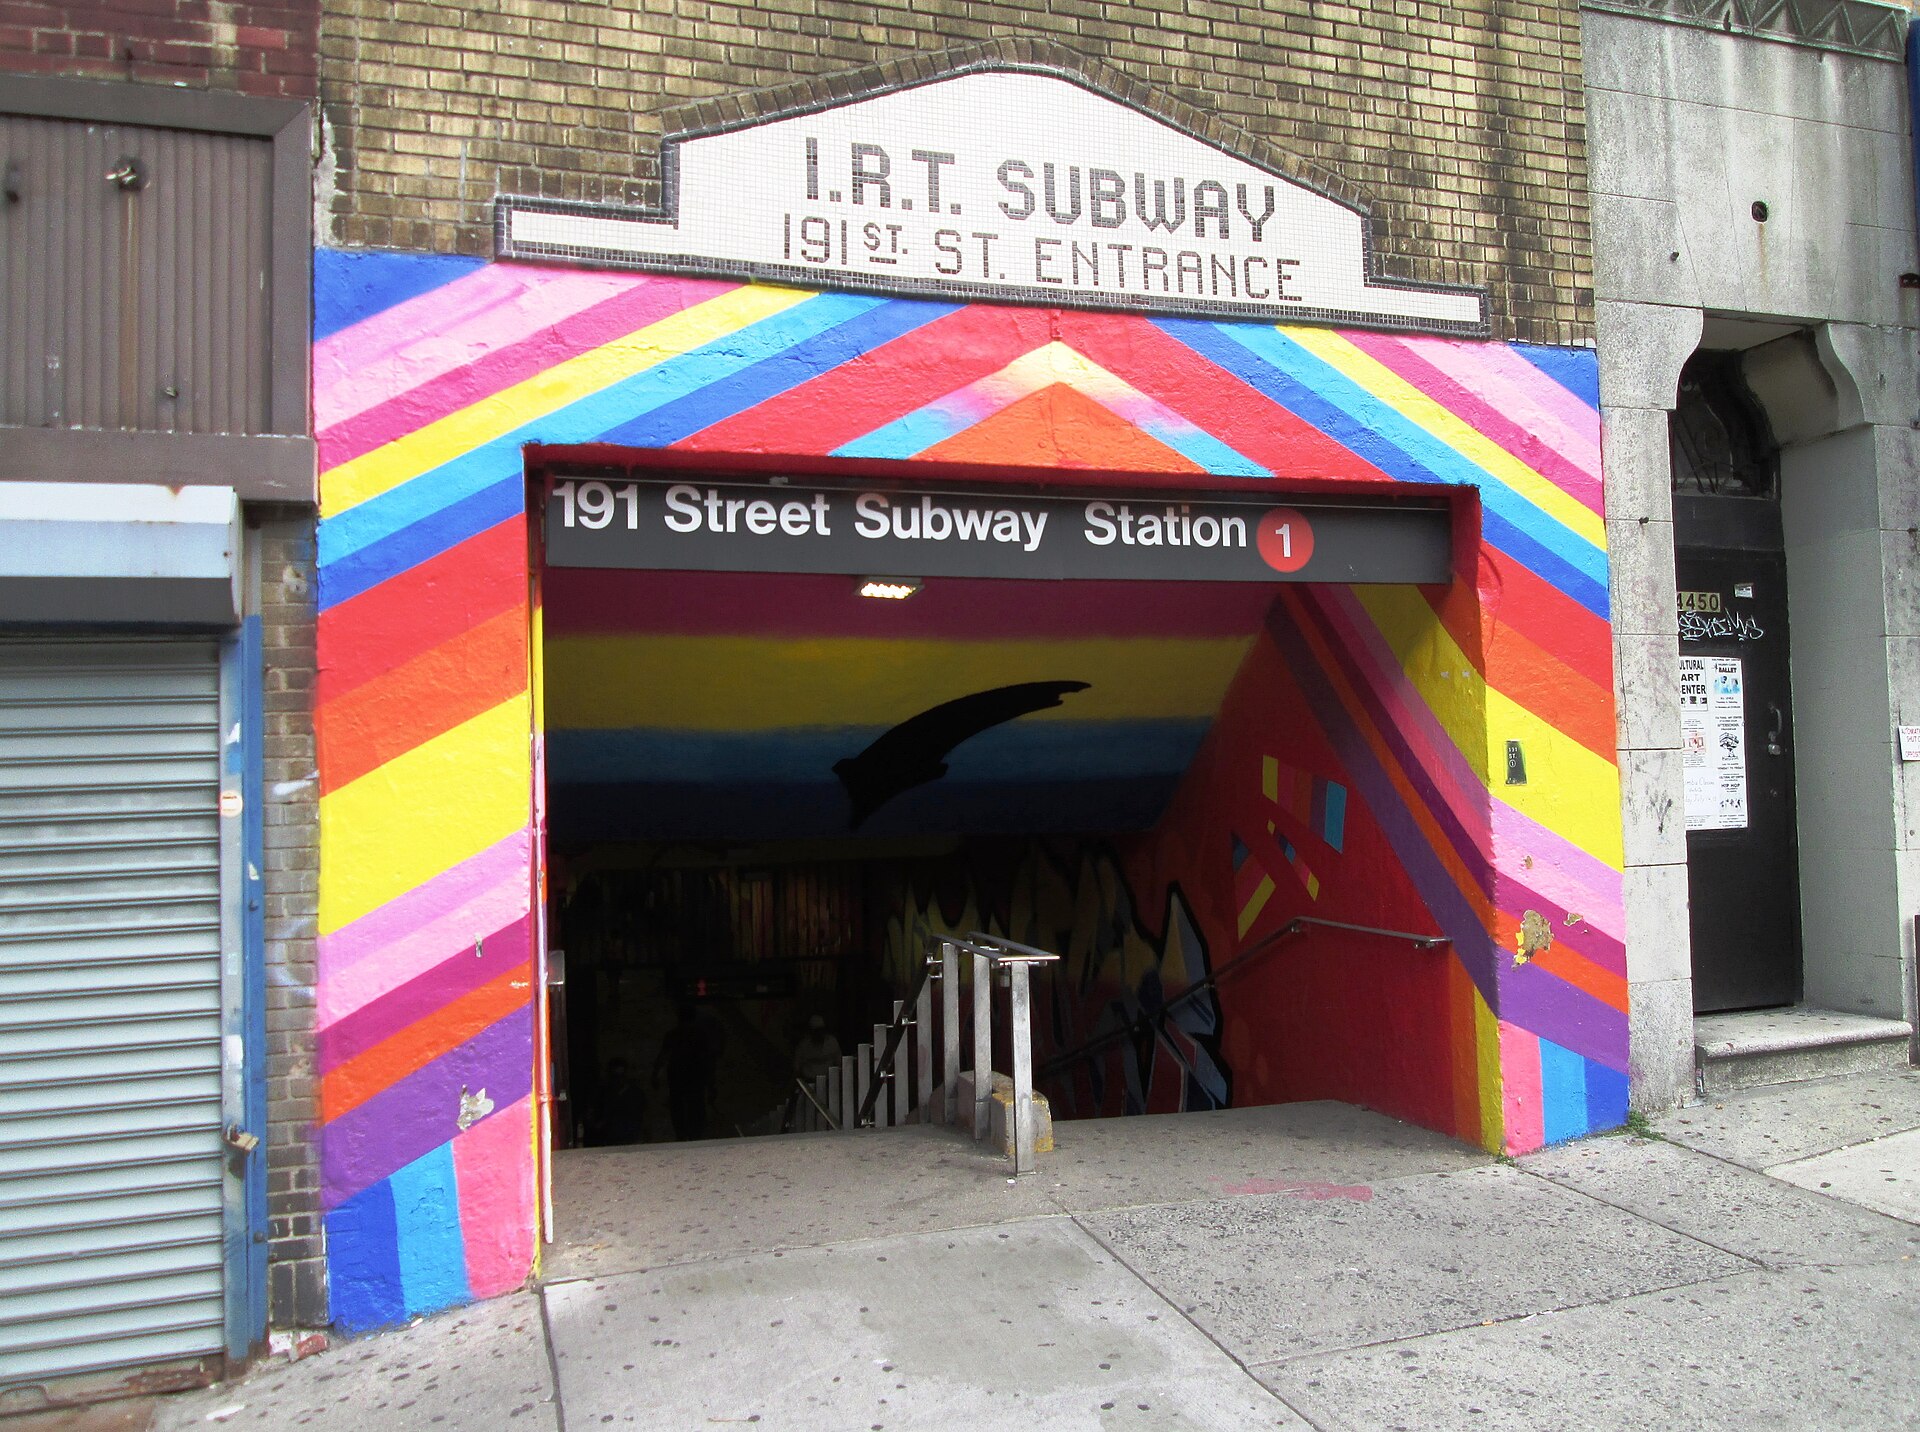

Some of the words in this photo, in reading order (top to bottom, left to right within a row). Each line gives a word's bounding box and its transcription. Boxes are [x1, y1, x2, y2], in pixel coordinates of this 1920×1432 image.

[805, 136, 962, 215] I.R.T.
[996, 158, 1276, 243] SUBWAY
[934, 228, 1006, 280] ST.
[1034, 236, 1303, 302] ENTRANCE
[551, 480, 639, 531] 191
[663, 484, 832, 537] Street
[853, 492, 1050, 553] Subway
[1083, 501, 1248, 549] Station
[1274, 522, 1293, 559] 1
[1677, 593, 1718, 610] 4450
[1679, 659, 1704, 670] ULTURAL
[1680, 673, 1701, 682] ART
[1680, 684, 1707, 695] ENTER
